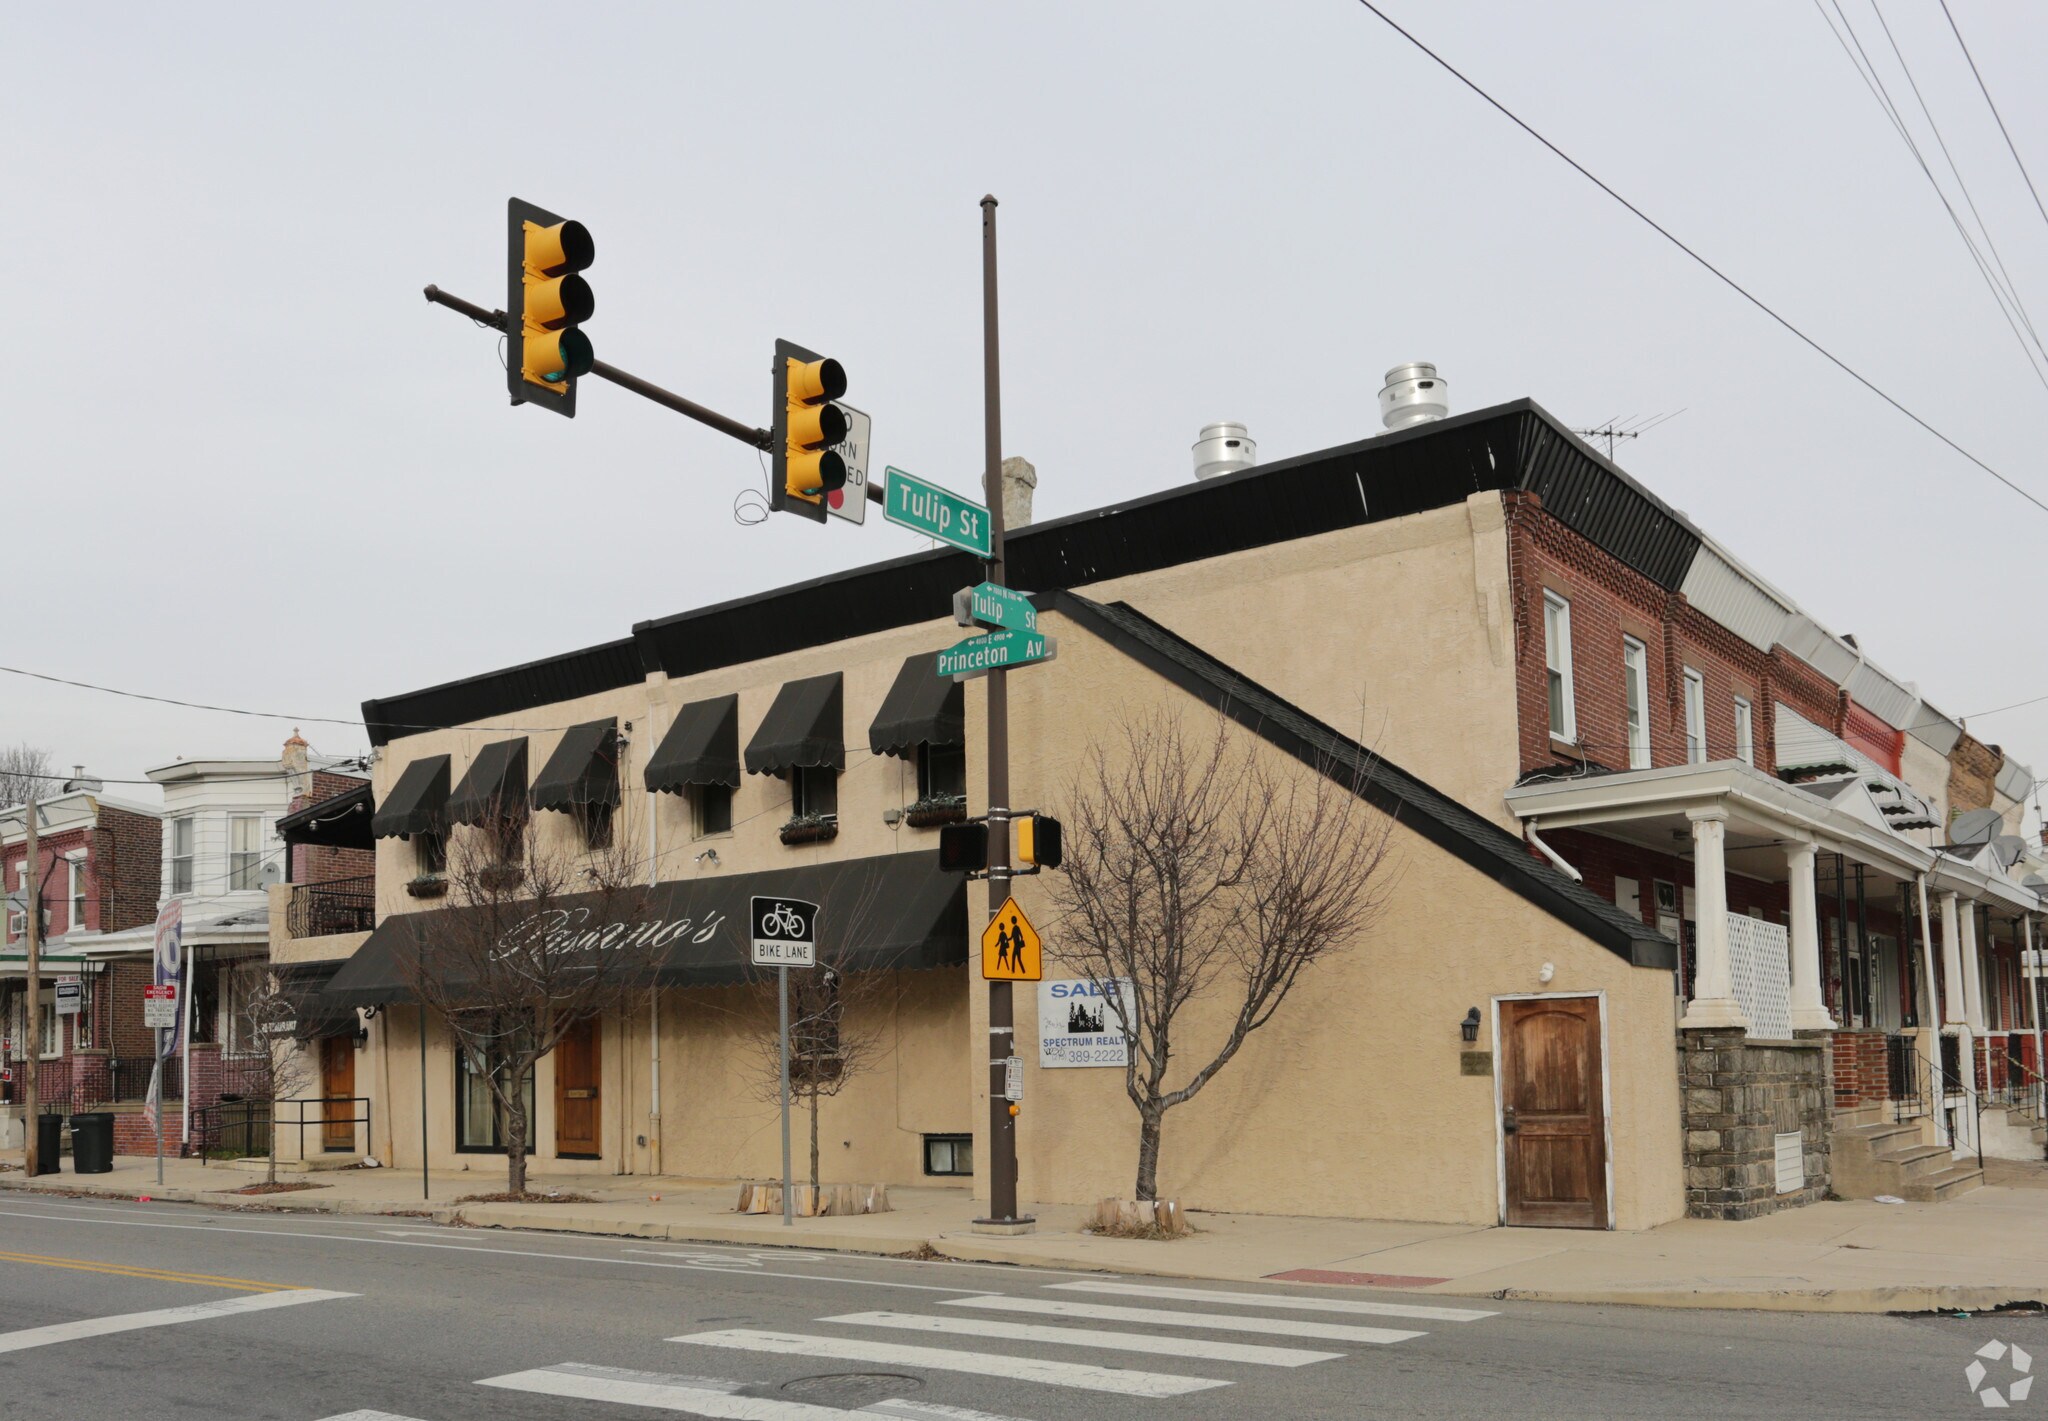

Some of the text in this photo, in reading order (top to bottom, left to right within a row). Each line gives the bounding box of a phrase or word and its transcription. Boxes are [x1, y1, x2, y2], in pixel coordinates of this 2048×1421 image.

[847, 465, 864, 486] ED
[900, 483, 979, 540] Tulip St
[973, 592, 1036, 629] Tulip St
[988, 634, 993, 645] E
[939, 640, 1043, 673] Princeton Av
[760, 944, 808, 959] BIKE LANE
[1051, 982, 1119, 998] SALE
[1043, 1036, 1126, 1047] SPECTRUM REALT
[1068, 1049, 1124, 1062] 389-2222
